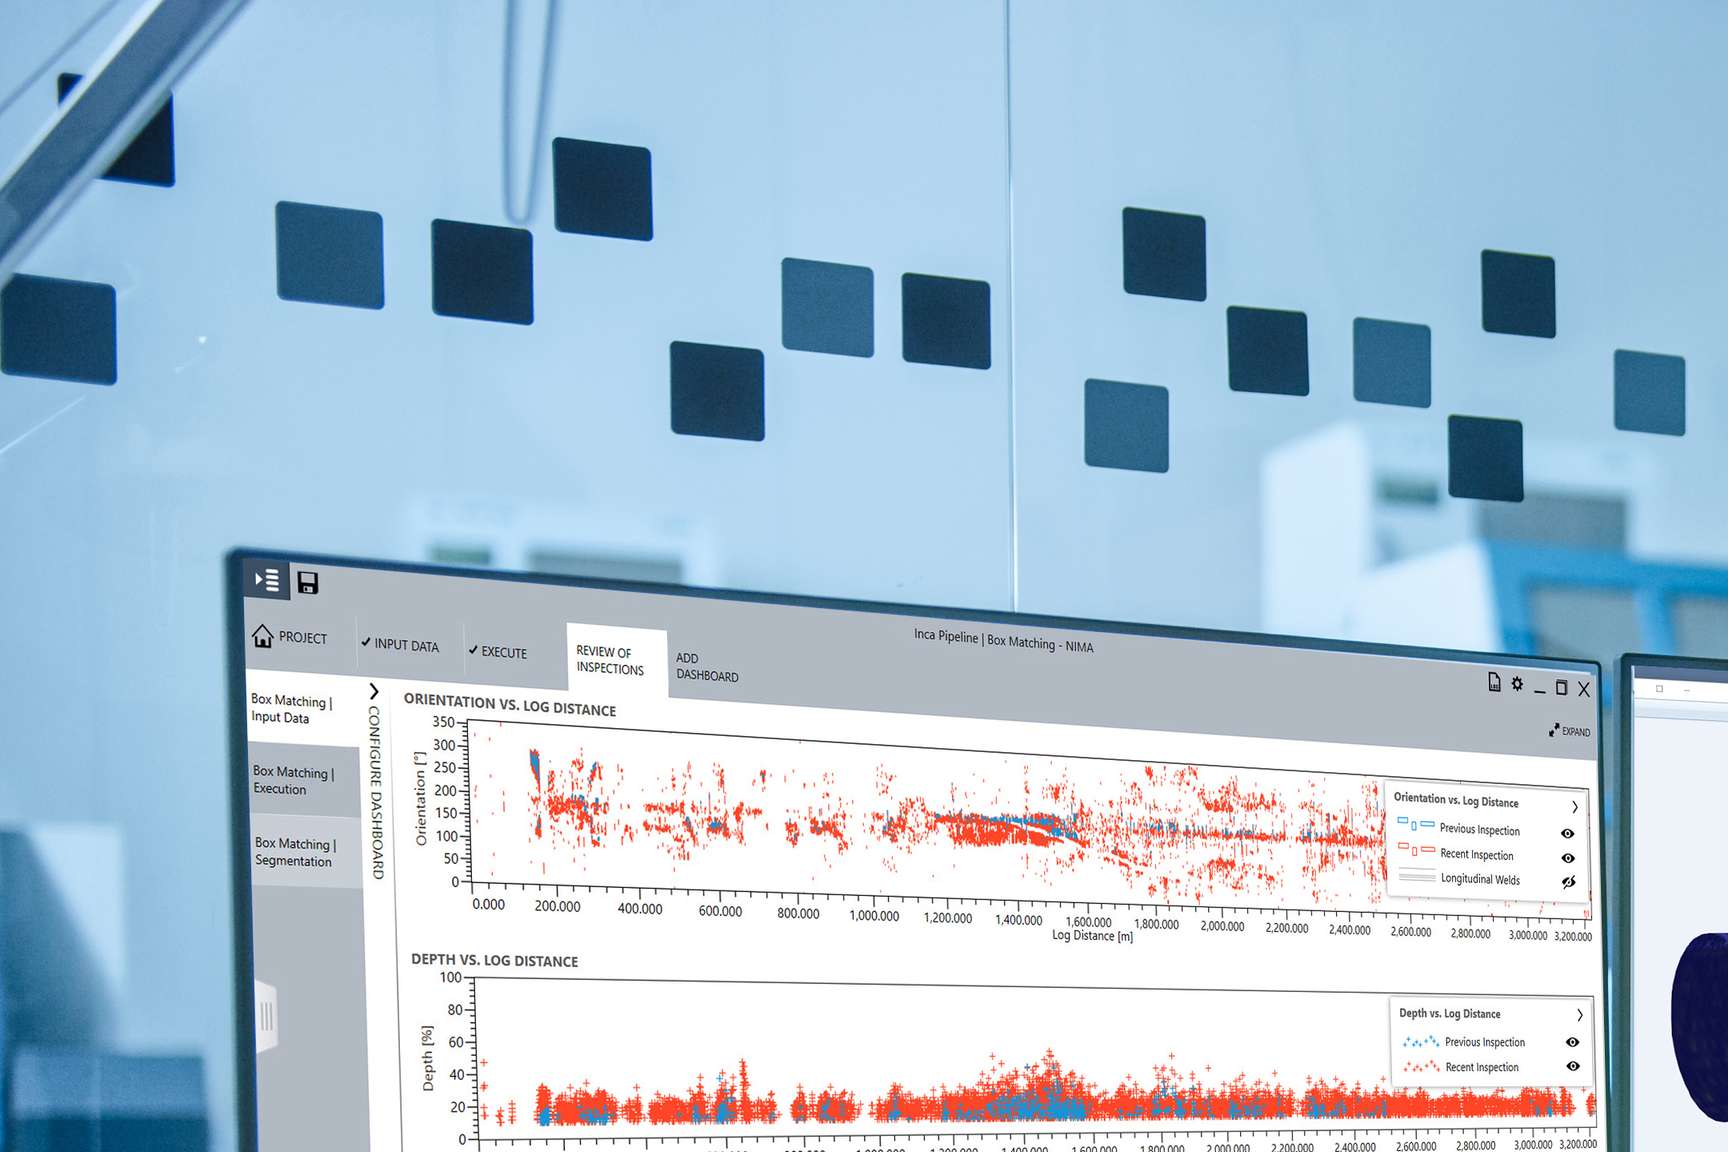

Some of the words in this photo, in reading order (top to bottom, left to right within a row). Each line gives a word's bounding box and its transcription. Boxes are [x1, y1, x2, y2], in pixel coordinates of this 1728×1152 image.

[279, 631, 327, 645] PROJECT
[914, 628, 936, 641] Inca
[938, 630, 978, 645] Pipeline
[987, 634, 1006, 646] Box
[1009, 636, 1055, 653] Matching
[1066, 640, 1094, 653] NIMA
[375, 638, 408, 651] INPUT
[412, 640, 440, 653] DATA
[482, 646, 527, 659] EXECUTE
[577, 645, 615, 658] REVIEW
[617, 648, 631, 659] OF
[676, 653, 699, 664] ADD
[577, 661, 644, 676] INSPECTIONS
[677, 668, 739, 683] DASHBOARD
[251, 693, 271, 704] Box
[275, 695, 326, 711] Matching
[404, 693, 496, 709] ORIENTATION
[500, 699, 520, 711] VS.
[524, 700, 550, 712] LOG
[554, 702, 616, 717] DISTANCE
[252, 710, 280, 724] Input
[284, 712, 309, 724] Data
[433, 716, 455, 728] 350
[1562, 727, 1591, 737] EXPAND
[368, 705, 382, 787] CONFIGURE
[434, 739, 455, 751] 300
[253, 765, 273, 776] Box
[277, 766, 328, 781] Matching
[434, 761, 456, 773] 250
[254, 782, 306, 795] Execution
[435, 785, 457, 796] 200
[1394, 792, 1446, 805] Orientation
[1448, 797, 1460, 805] vs.
[1463, 796, 1479, 808] Log
[1481, 797, 1519, 808] Distance
[415, 771, 427, 846] Orientation
[436, 807, 457, 819] 150
[371, 792, 384, 880] DASHBOARD
[437, 831, 458, 842] 100
[1440, 823, 1475, 834] Previous
[1478, 824, 1520, 839] Inspection
[255, 837, 275, 848] Box
[279, 838, 330, 853] Matching
[255, 854, 332, 868] Segmentation
[444, 853, 459, 864] 50
[1441, 848, 1469, 859] Recent
[1471, 849, 1514, 863] Inspection
[452, 876, 459, 887] 0
[1441, 873, 1493, 887] Longitudinal
[1495, 874, 1520, 885] Welds
[473, 899, 505, 910] 0.000
[535, 901, 580, 912] 200.000
[618, 903, 663, 915] 400.000
[778, 907, 820, 920] 800.000
[850, 910, 900, 923] 1,000.000
[924, 912, 972, 925] 1,200.000
[1066, 916, 1112, 929] 1,600.000
[1135, 918, 1179, 931] 1,800.000
[1201, 921, 1244, 933] 2,000.000
[1329, 924, 1371, 936] 2,400.000
[1451, 928, 1491, 939] 2,800.000
[1509, 929, 1548, 941] 3,000.000
[1554, 930, 1592, 942] 3,200.000
[1052, 929, 1071, 943] Log
[1073, 929, 1115, 942] Distance
[1118, 931, 1133, 944] [m]
[412, 953, 456, 965] DEPTH
[459, 955, 480, 966] VS.
[485, 955, 510, 966] LOG
[515, 956, 578, 967] DISTANCE
[440, 972, 462, 983] 100
[448, 1004, 463, 1015] 80
[1400, 1008, 1428, 1019] Depth
[1430, 1010, 1442, 1018] vs.
[1444, 1008, 1461, 1021] Log
[1463, 1009, 1501, 1019] Distance
[422, 1025, 434, 1046] [%]
[449, 1037, 464, 1048] 60
[1445, 1037, 1480, 1047] Previous
[1483, 1037, 1525, 1049] Inspection
[422, 1051, 436, 1091] Depth
[450, 1069, 465, 1080] 40
[1446, 1062, 1474, 1072] Recent
[1476, 1062, 1519, 1074] Inspection
[451, 1102, 465, 1112] 20
[459, 1134, 466, 1145] 0
[1456, 1140, 1496, 1152] 2,800.000
[1559, 1139, 1598, 1150] 3,200.000
